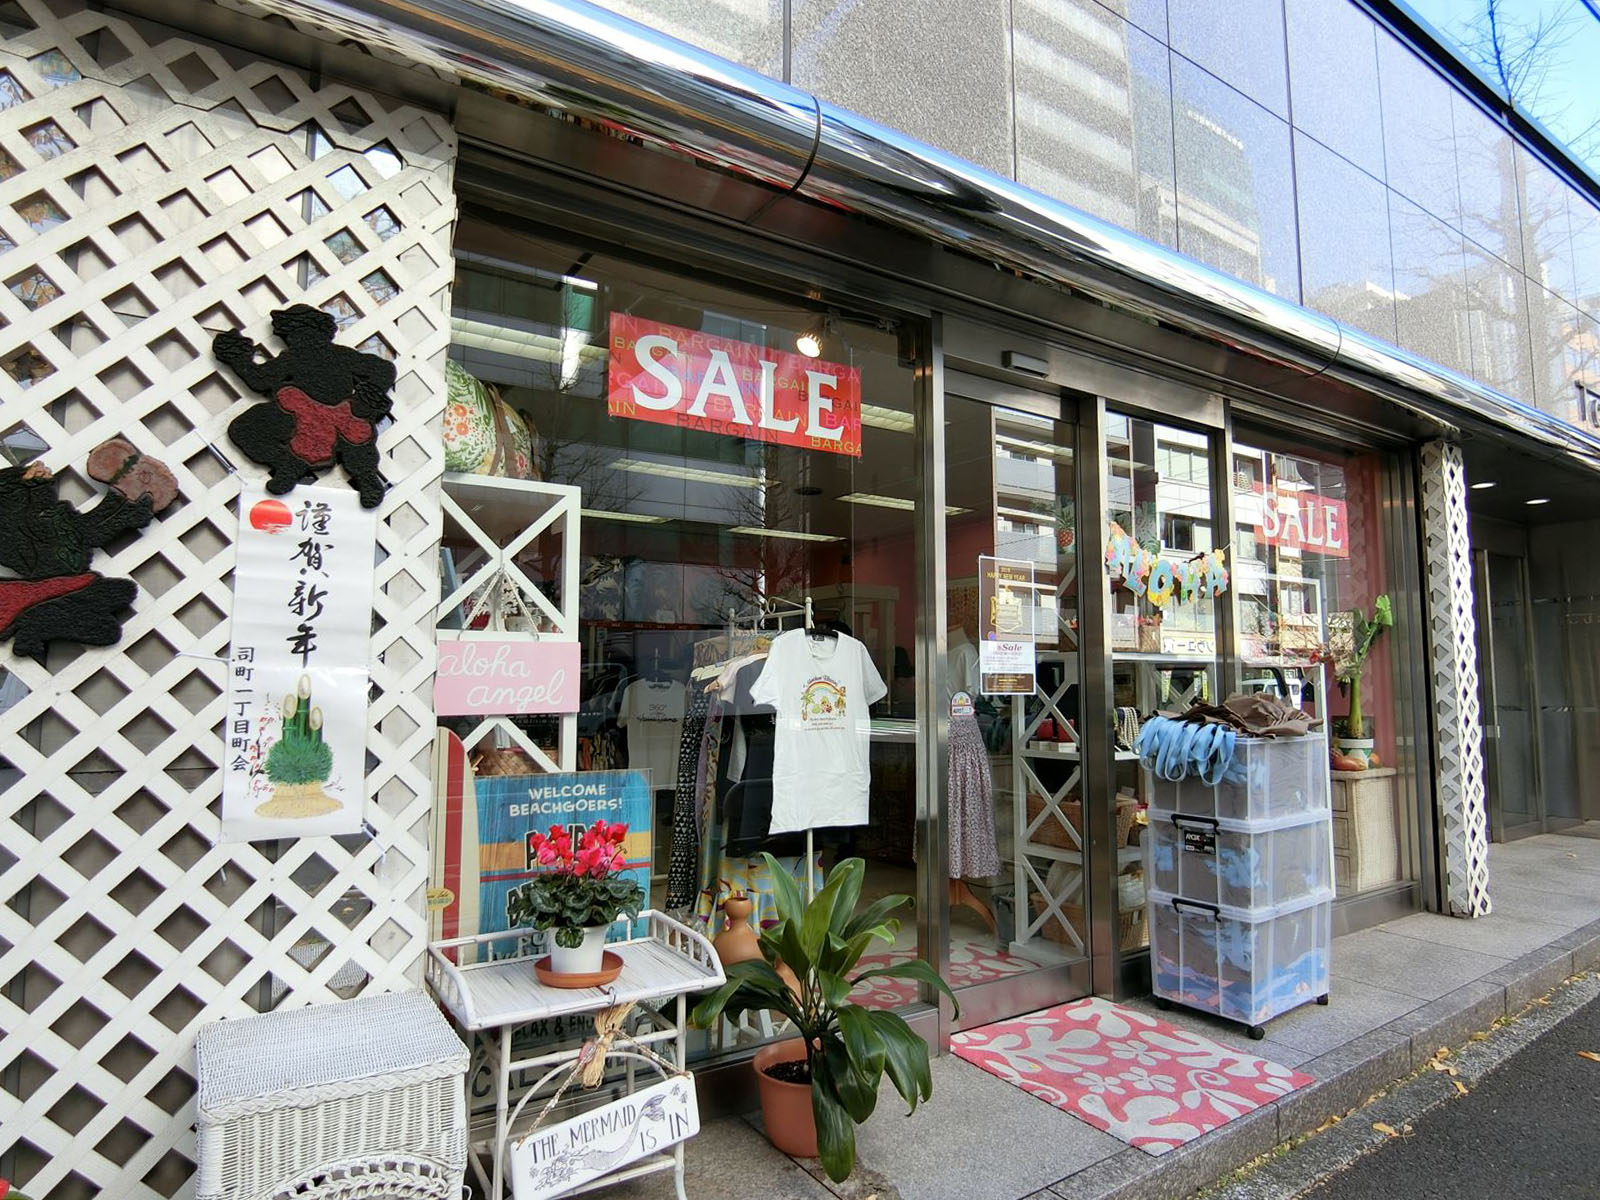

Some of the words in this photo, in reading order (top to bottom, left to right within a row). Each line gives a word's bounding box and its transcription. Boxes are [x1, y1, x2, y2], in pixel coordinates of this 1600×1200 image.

[629, 334, 845, 441] SALE
[1262, 491, 1342, 549] SALE
[286, 500, 333, 668] 謹賀新年
[438, 643, 531, 678] aloha
[231, 646, 255, 773] 司町一丁目町会
[465, 668, 565, 712] angel
[509, 798, 623, 817] BEACHGOERS!
[528, 783, 607, 801] WELCOME
[528, 1132, 560, 1164] THE
[569, 1103, 637, 1149] MERMAID
[640, 1129, 657, 1152] IS
[668, 1108, 690, 1141] IN
